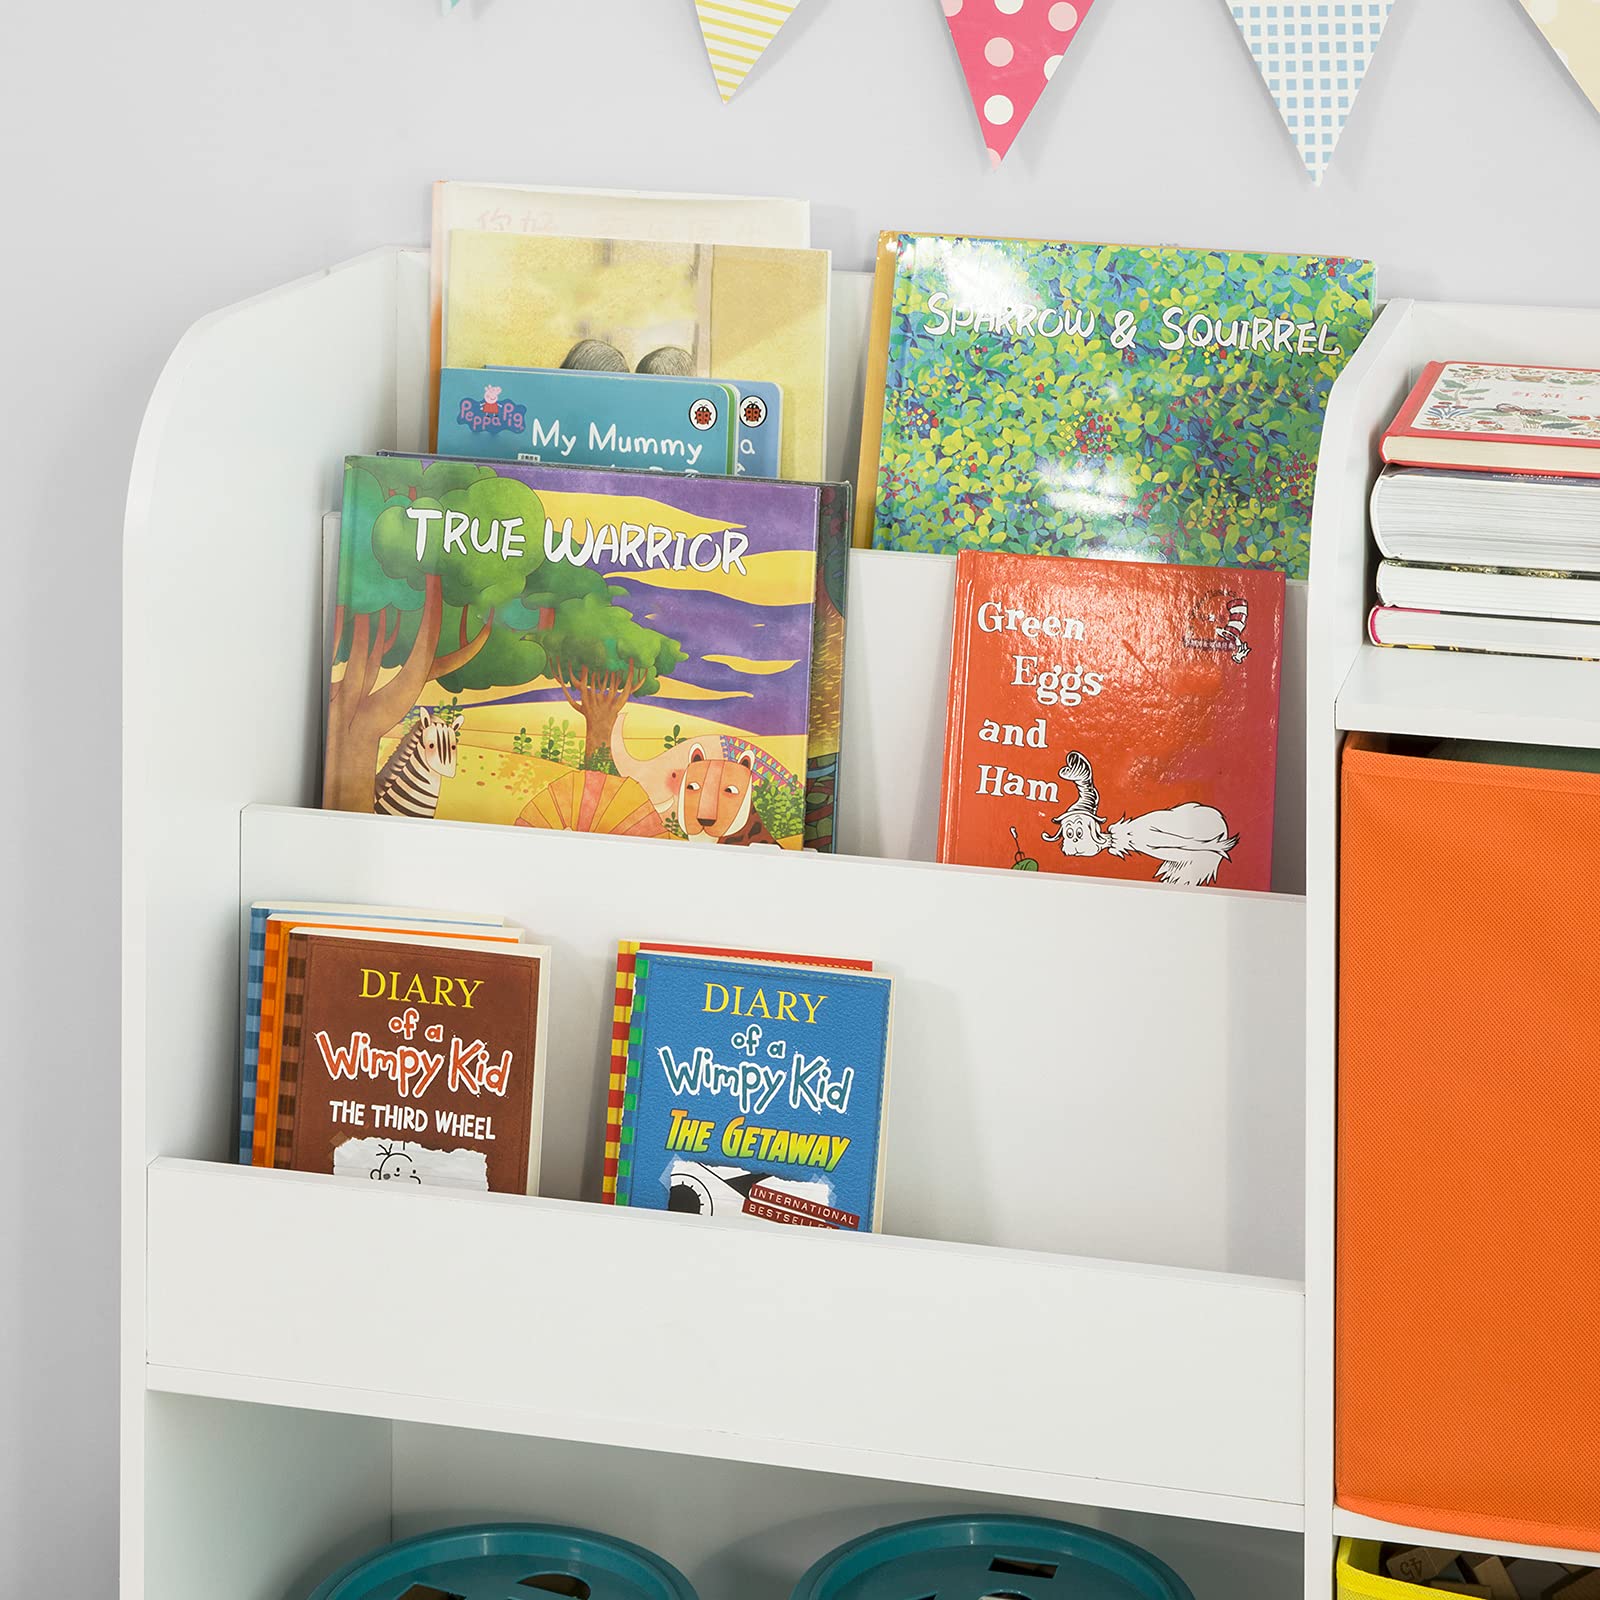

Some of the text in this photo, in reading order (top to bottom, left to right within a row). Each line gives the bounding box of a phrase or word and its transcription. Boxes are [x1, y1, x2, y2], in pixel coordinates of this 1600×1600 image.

[923, 290, 1341, 356] SPARROW & SQUIRREL
[461, 399, 523, 431] Peppa Pig
[532, 418, 702, 465] My Mummy
[405, 506, 749, 576] TRUE WARRIOR
[976, 601, 1085, 641] Green
[1010, 654, 1104, 706] Eggs
[978, 718, 1048, 749] and
[975, 764, 1059, 804] Ham
[358, 968, 485, 1009] DIARY
[701, 982, 828, 1024] DIARY
[389, 1007, 444, 1042] of a
[731, 1024, 786, 1059] of a
[314, 1030, 513, 1098] Wimpy Kid
[657, 1046, 854, 1114] Wimpy Kid
[329, 1100, 495, 1140] THE THIRD WHEEL
[665, 1109, 851, 1172] THE GETAWAY
[753, 1188, 855, 1226] INTERNATIONAL
[1400, 1557, 1422, 1579] 45
